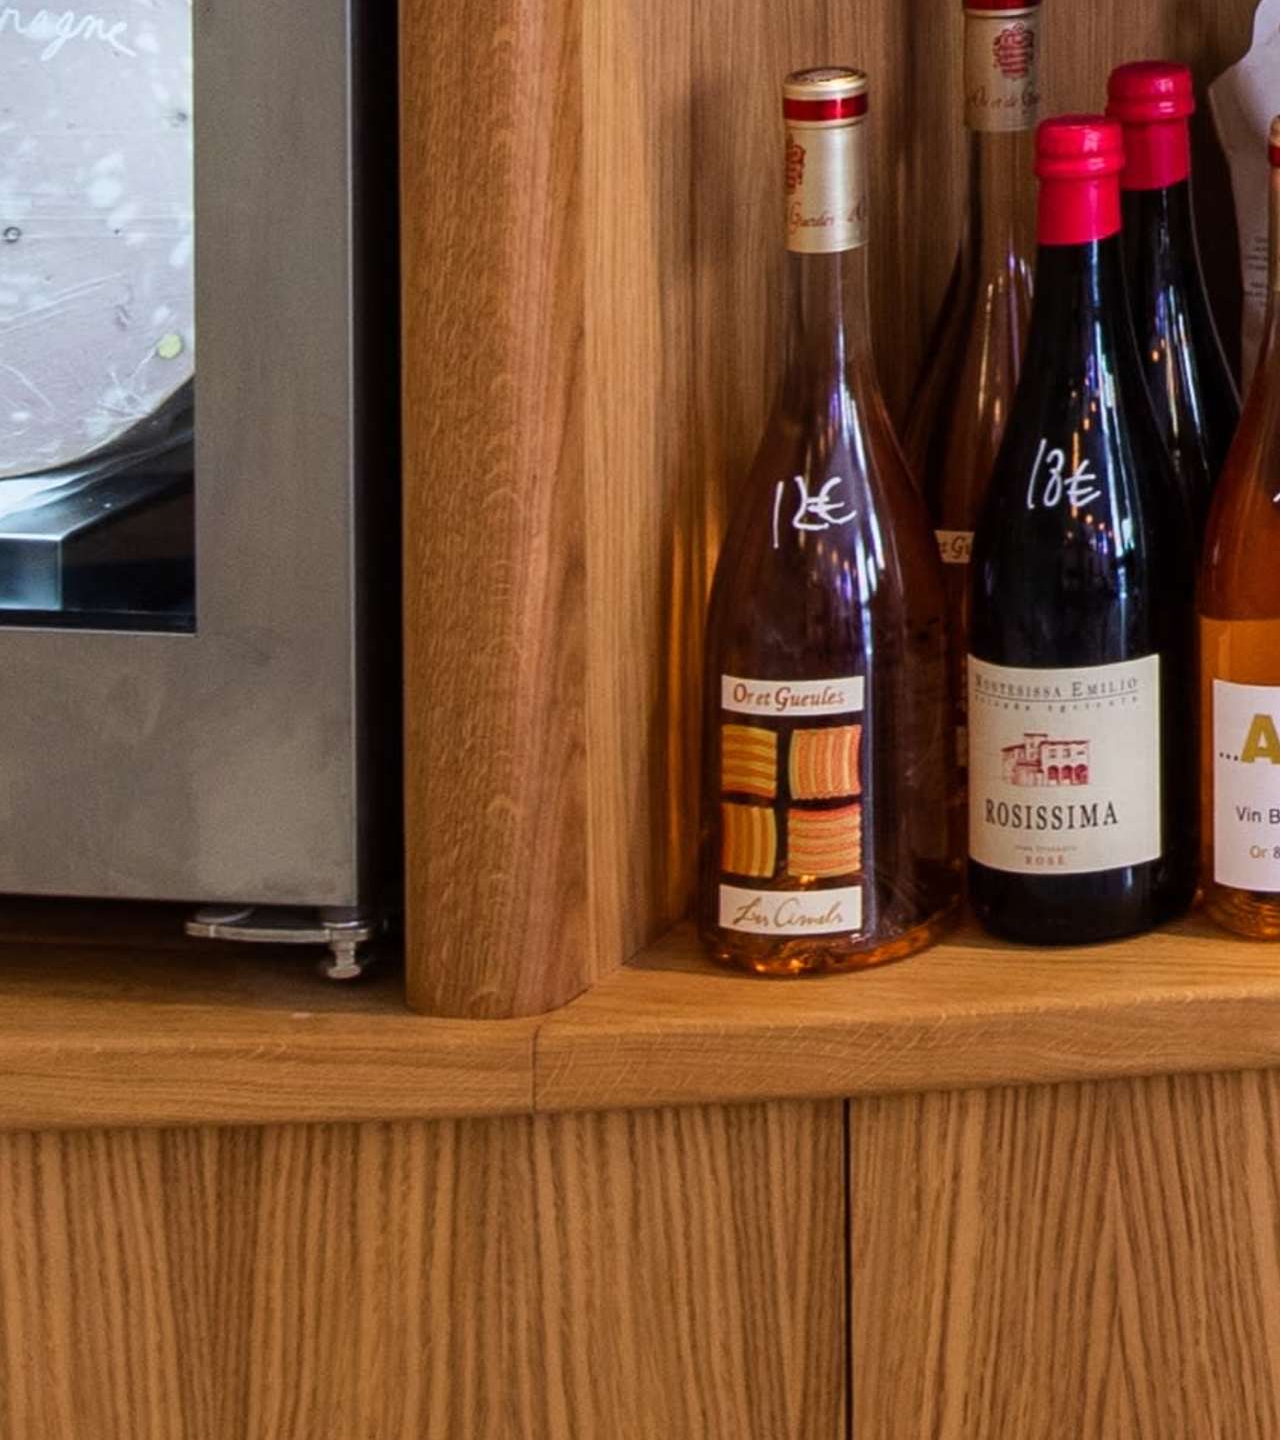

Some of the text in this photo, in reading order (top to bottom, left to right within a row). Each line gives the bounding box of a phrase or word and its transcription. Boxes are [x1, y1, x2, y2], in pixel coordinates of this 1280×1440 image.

[732, 683, 846, 713] Or et Gueules
[1072, 677, 1139, 698] EMILIO
[984, 798, 1120, 831] ROSISSIMA
[1235, 805, 1262, 823] Vin
[1249, 845, 1267, 859] Or
